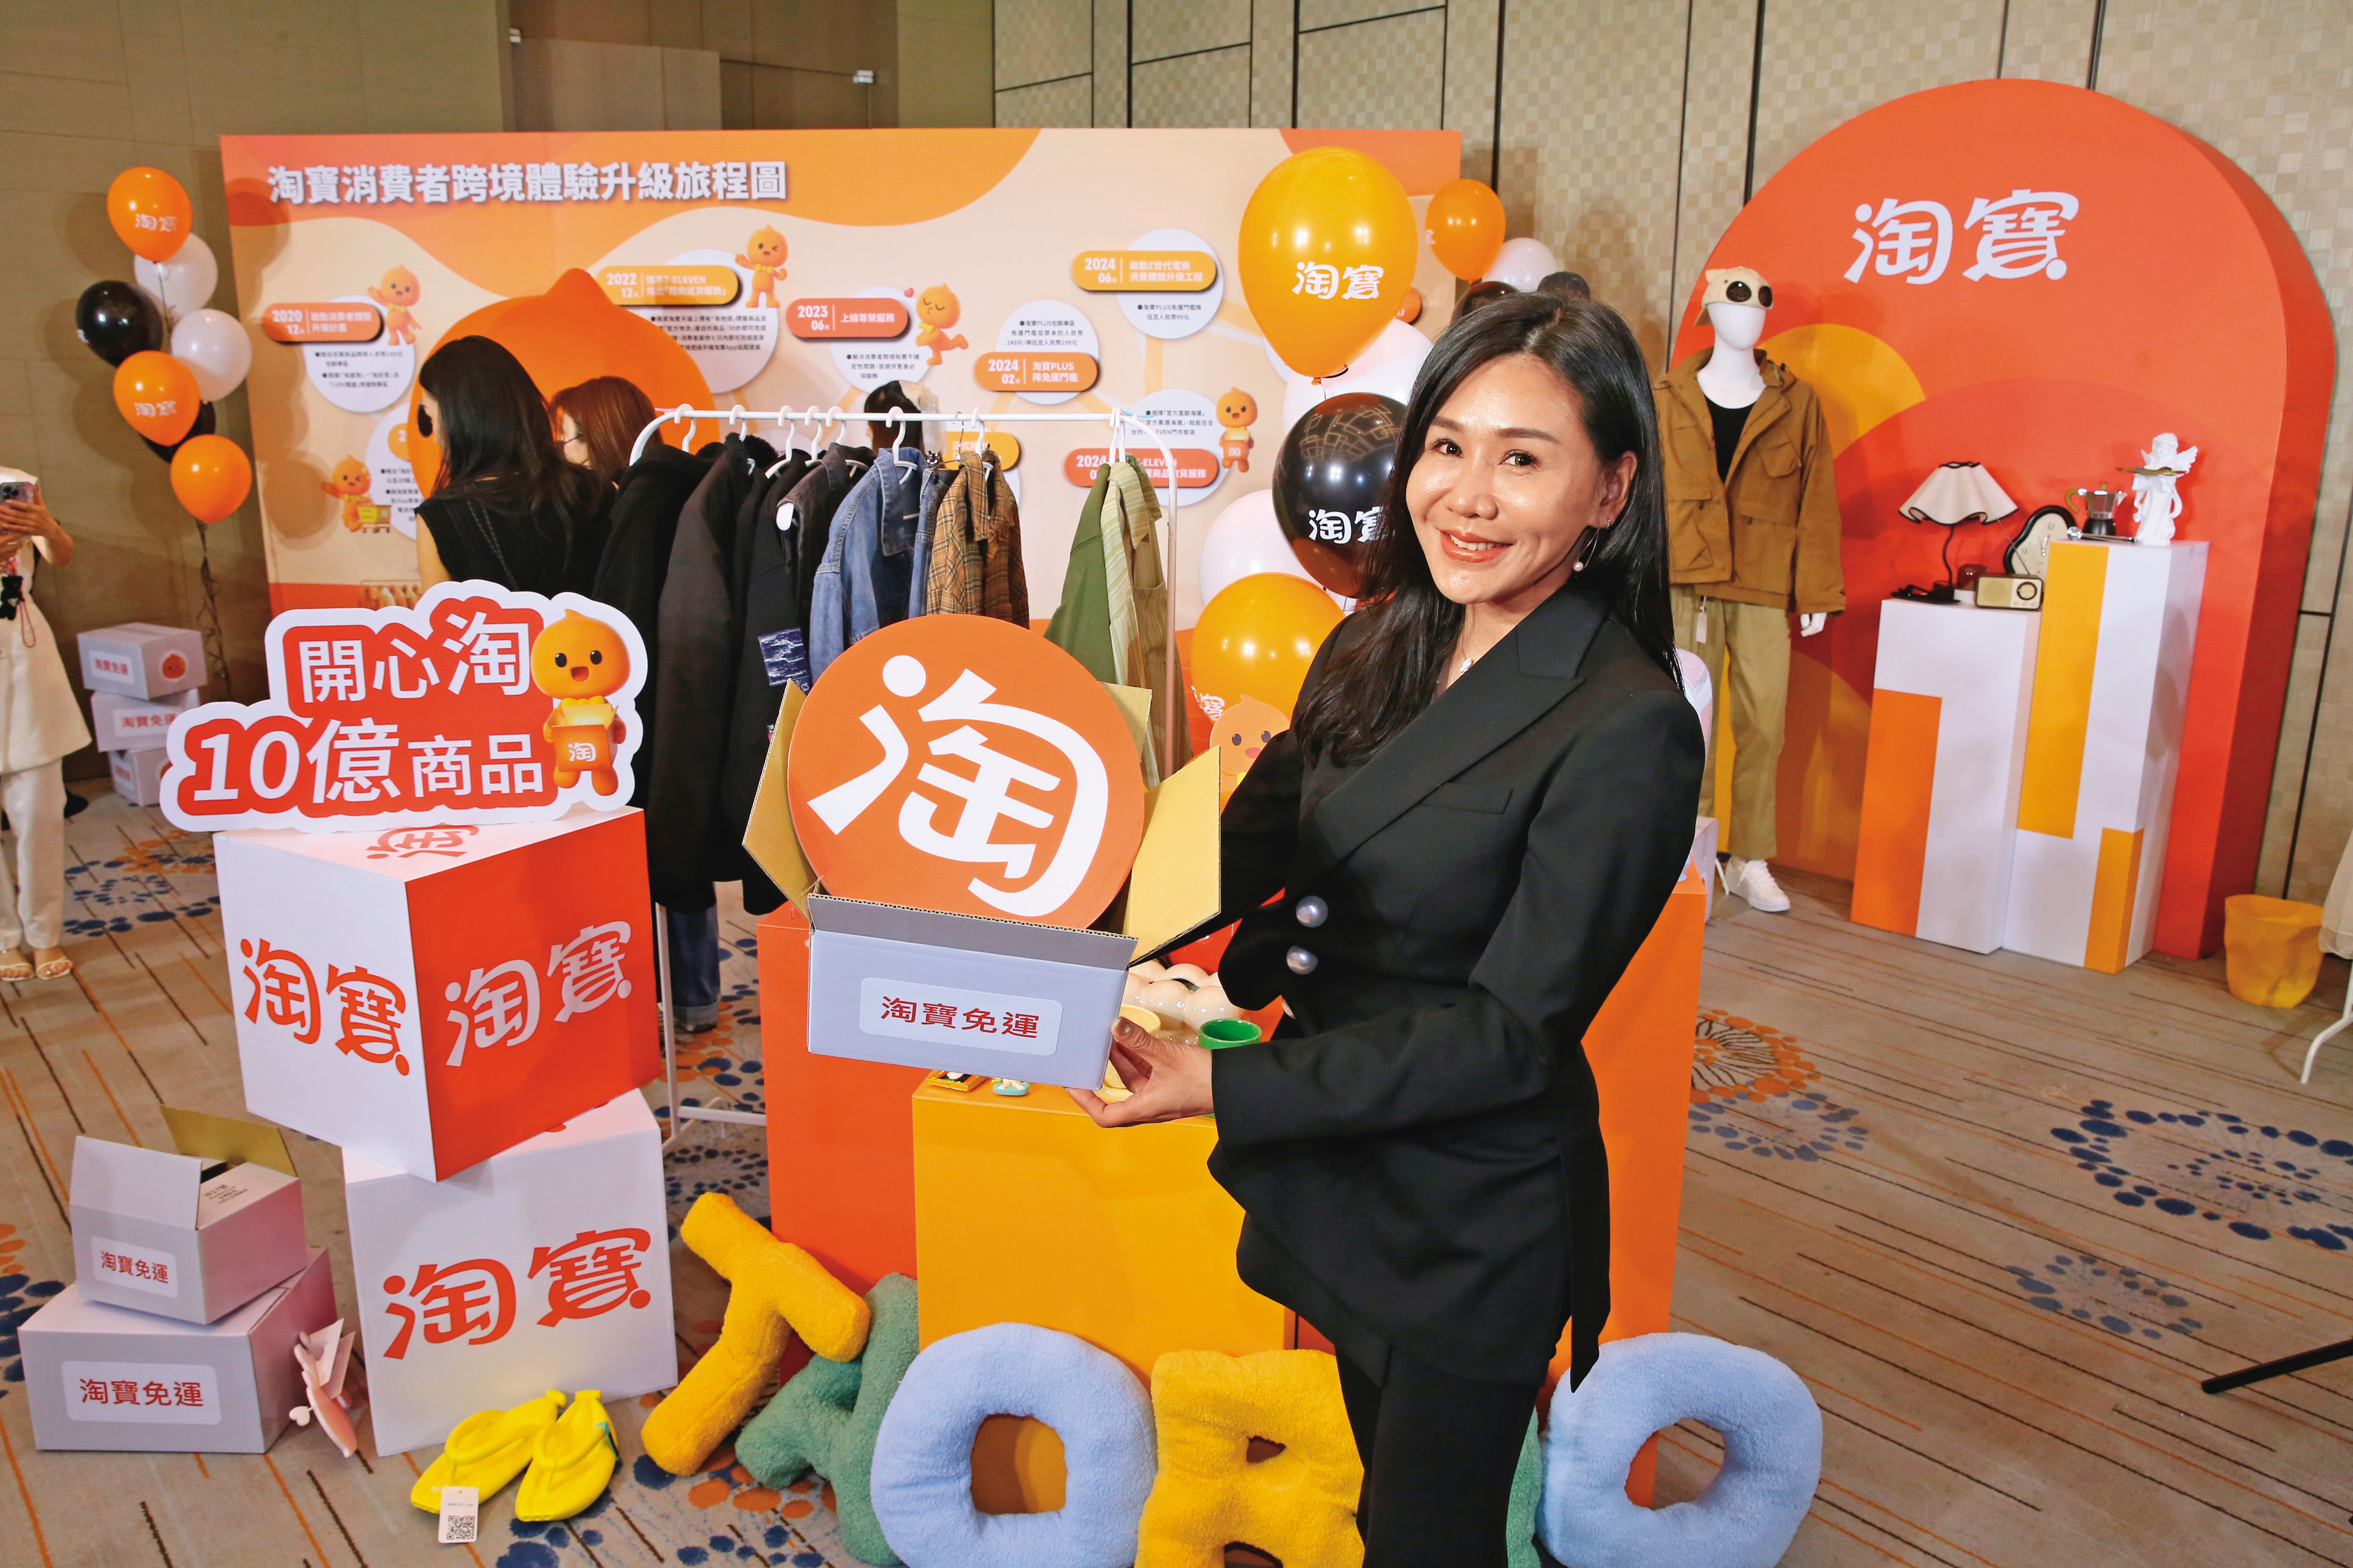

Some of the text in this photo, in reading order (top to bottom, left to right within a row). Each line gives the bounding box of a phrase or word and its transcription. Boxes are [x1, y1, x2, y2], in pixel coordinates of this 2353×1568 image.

[268, 162, 786, 203] 淘寶消費者跨境體驗升級旅程圖
[1844, 189, 2080, 285] 淘寶
[606, 273, 637, 286] 2022
[1084, 258, 1116, 270] 2024
[1292, 262, 1383, 300] 淘寶
[272, 310, 303, 322] 2020
[797, 305, 828, 318] 2023
[988, 359, 1019, 372] 2024
[1032, 361, 1075, 371] 淘寶PLUS
[298, 611, 531, 703] 開心淘
[193, 717, 544, 805] 10億商品
[568, 742, 596, 763] 淘
[807, 654, 1109, 917] 淘
[240, 938, 410, 1076] 淘寶
[444, 920, 632, 1067] 淘寶
[881, 996, 1040, 1038] 淘寶免運
[100, 1250, 169, 1284] 淘寶免運
[383, 1227, 651, 1360] 淘寶
[79, 1378, 204, 1407] 淘寶免運
